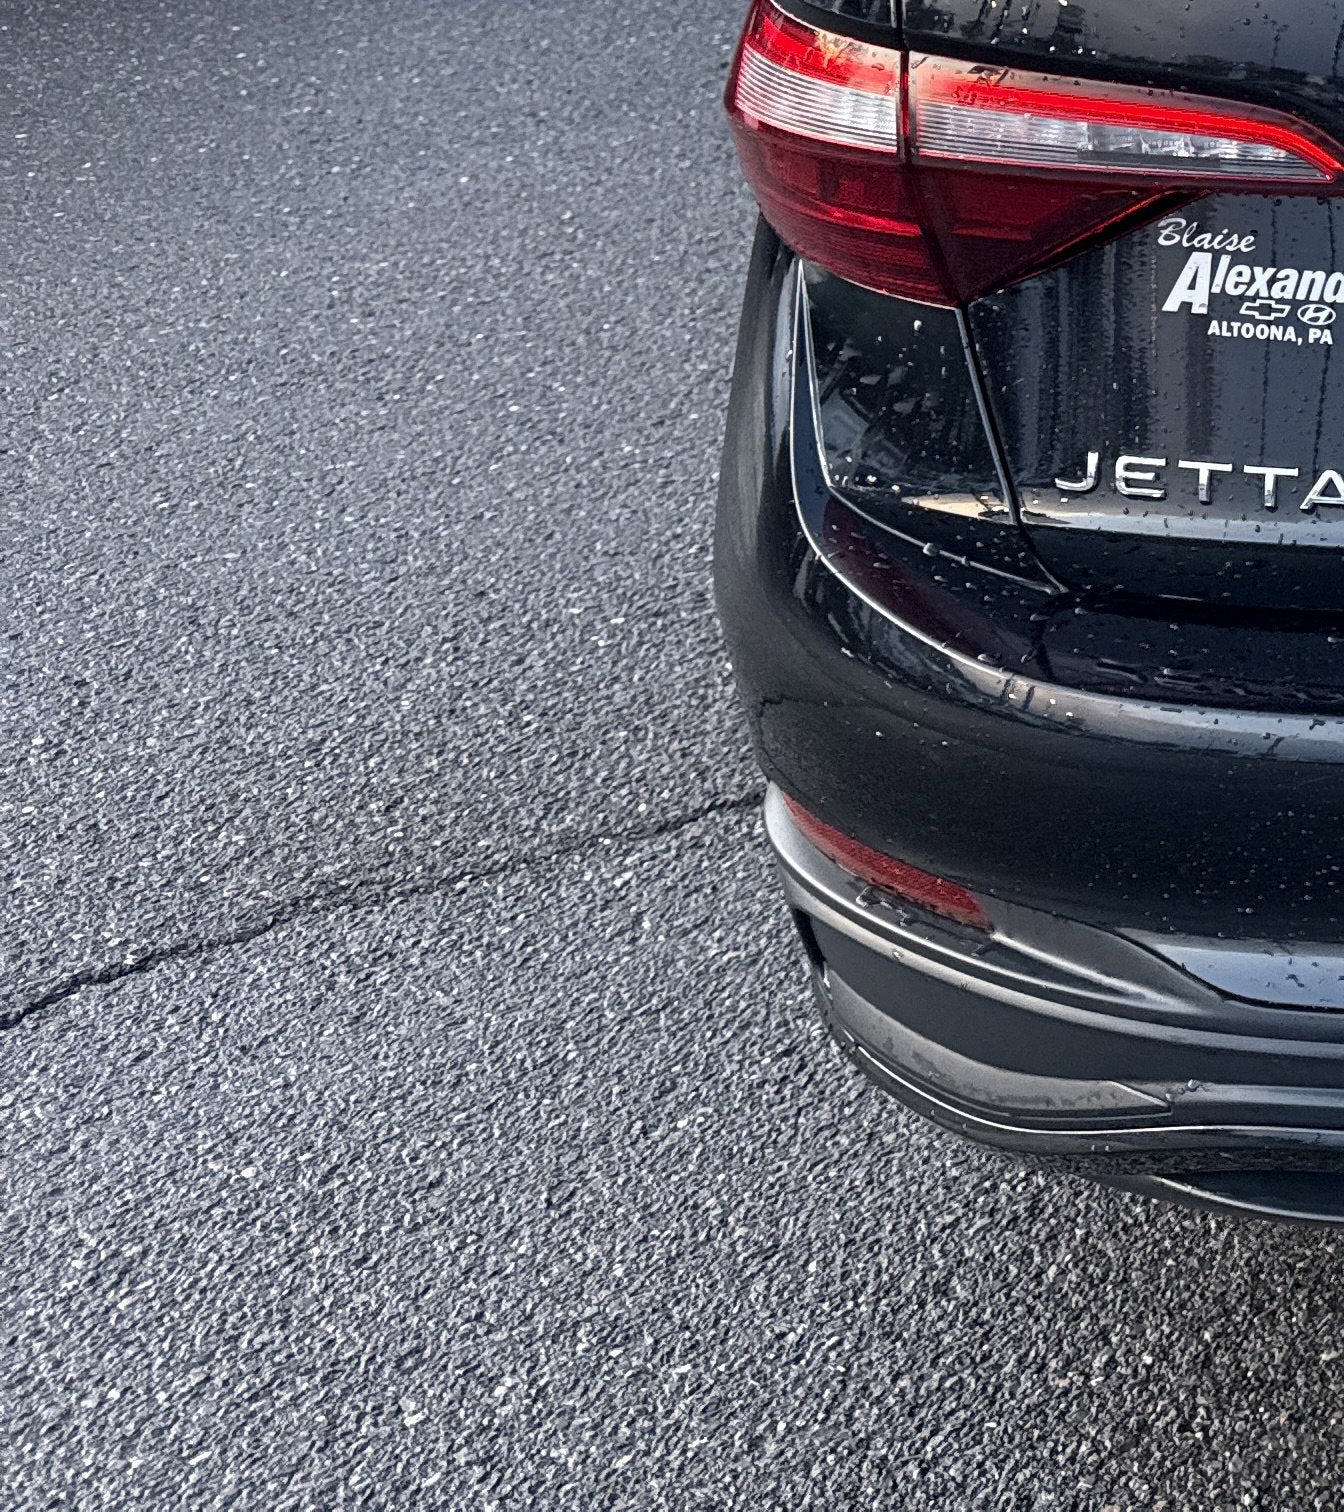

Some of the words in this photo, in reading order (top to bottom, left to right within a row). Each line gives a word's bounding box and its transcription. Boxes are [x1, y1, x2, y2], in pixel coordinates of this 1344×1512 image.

[1157, 217, 1256, 253] Blaise
[1207, 319, 1303, 346] ALTOONA,
[1308, 327, 1334, 345] PA
